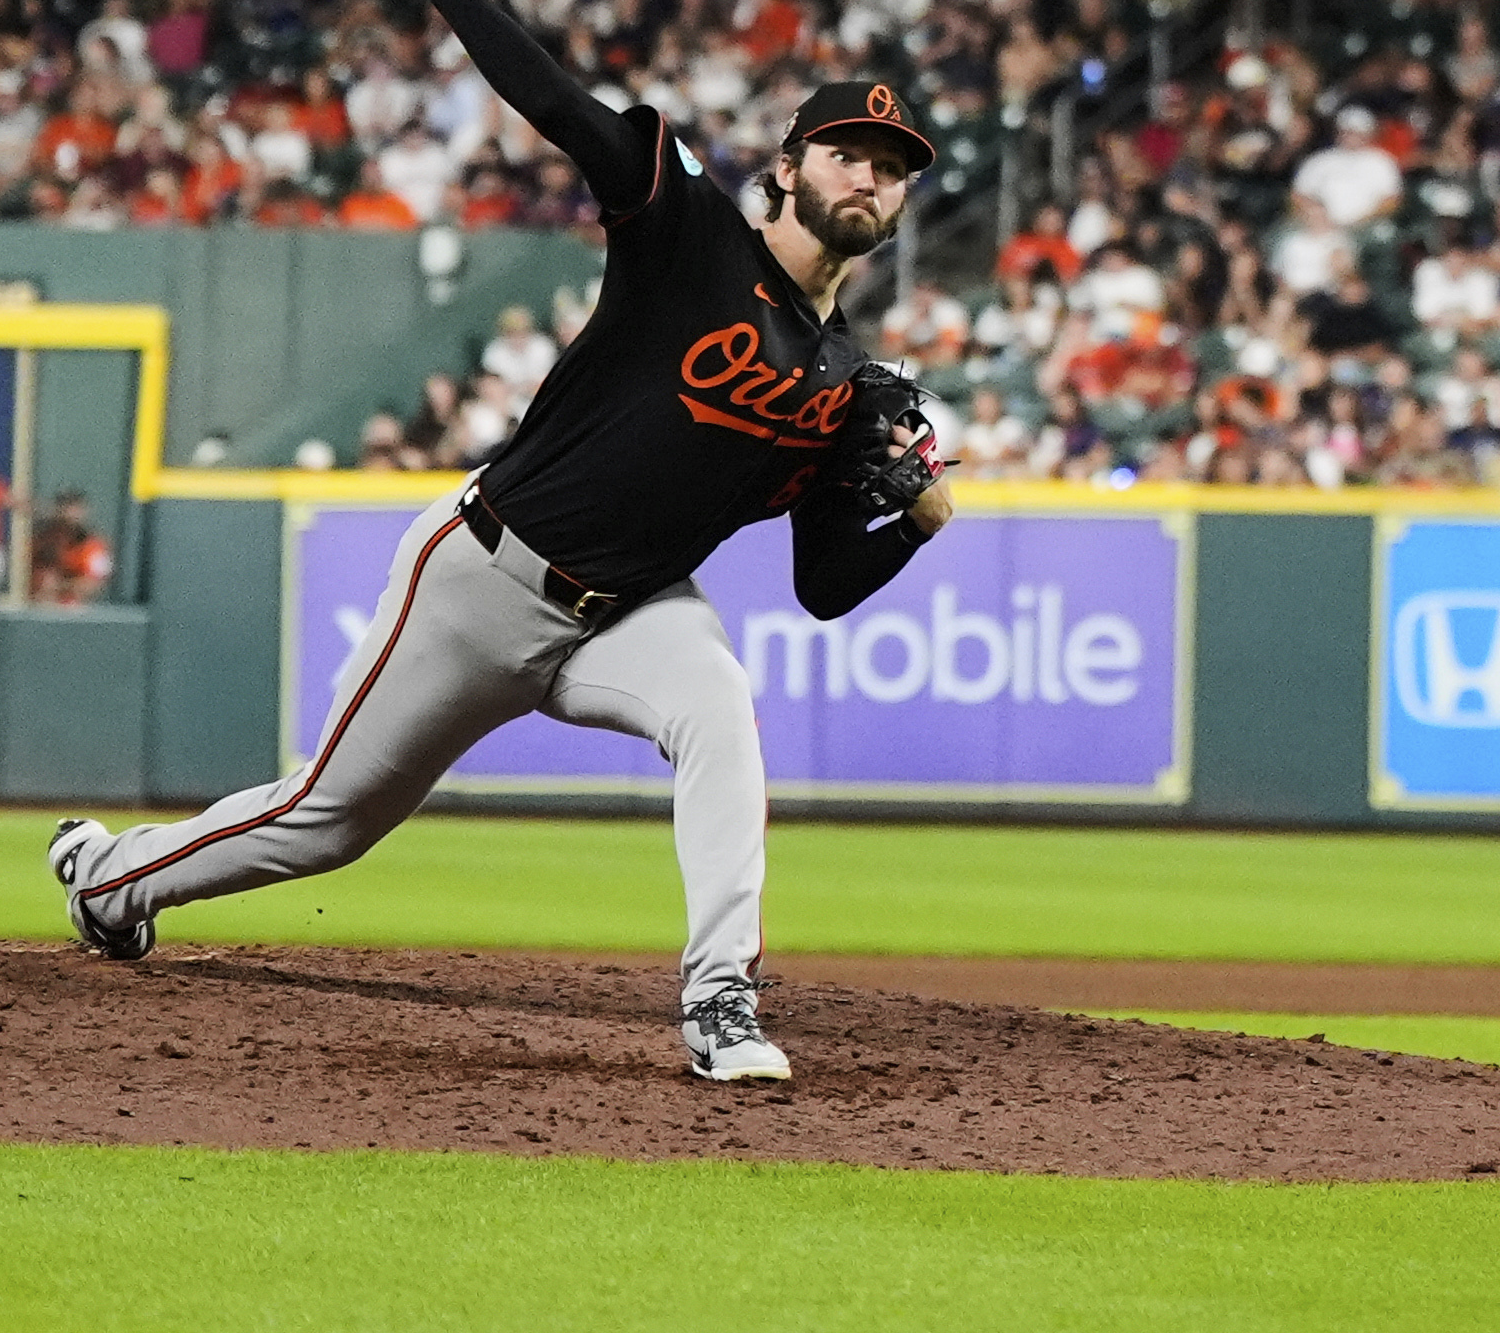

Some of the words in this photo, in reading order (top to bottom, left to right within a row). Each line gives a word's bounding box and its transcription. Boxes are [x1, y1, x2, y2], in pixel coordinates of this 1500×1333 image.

[866, 84, 901, 122] O's
[680, 322, 854, 434] Oriol
[743, 585, 1144, 707] mobile
